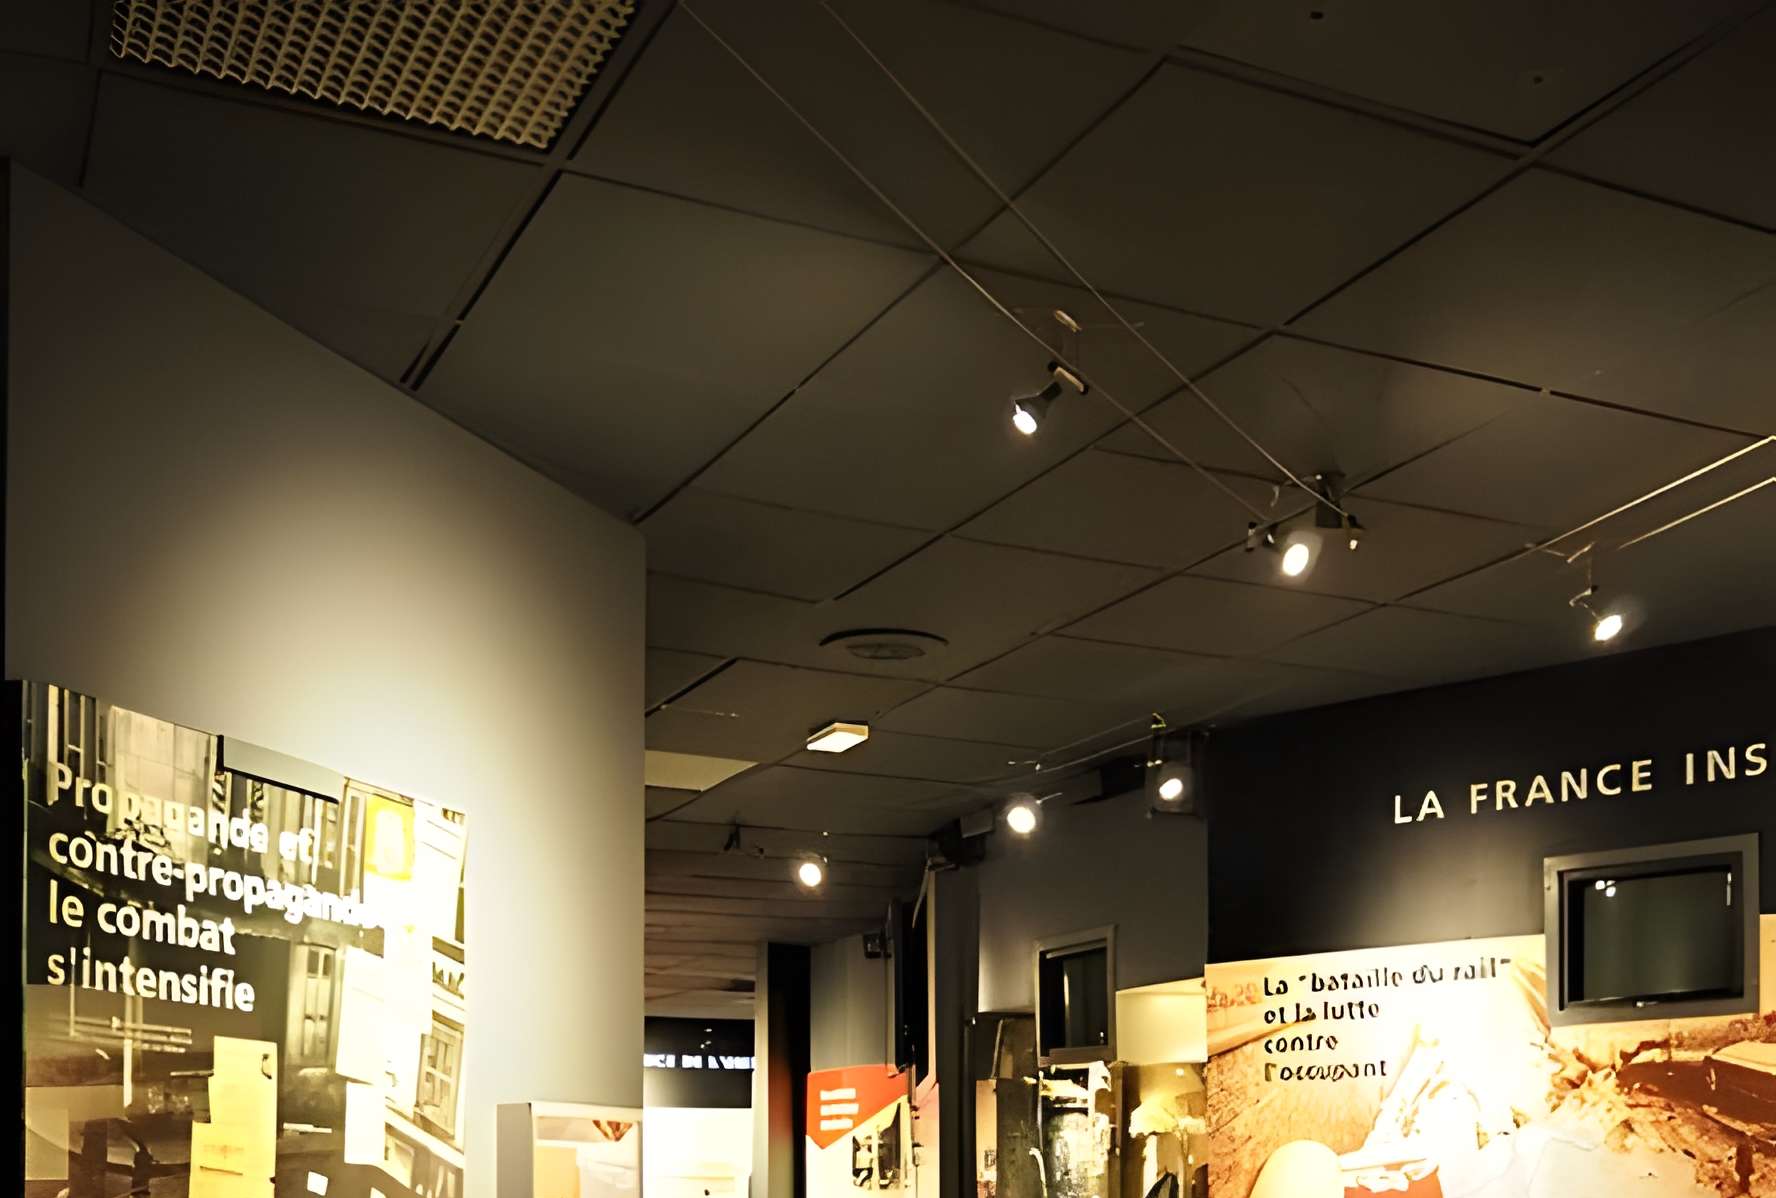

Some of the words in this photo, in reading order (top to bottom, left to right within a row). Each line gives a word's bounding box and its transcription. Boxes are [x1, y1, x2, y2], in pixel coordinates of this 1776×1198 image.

[46, 761, 268, 854] Propagande
[279, 827, 316, 865] et
[1394, 790, 1445, 824] LA
[1470, 759, 1652, 814] FRANCE
[1685, 743, 1768, 785] INS
[50, 879, 84, 928] le
[97, 904, 236, 956] combat
[47, 946, 256, 1012] s'intensifie
[1264, 976, 1289, 996] La
[1412, 964, 1444, 984] du
[1264, 1006, 1286, 1024] et
